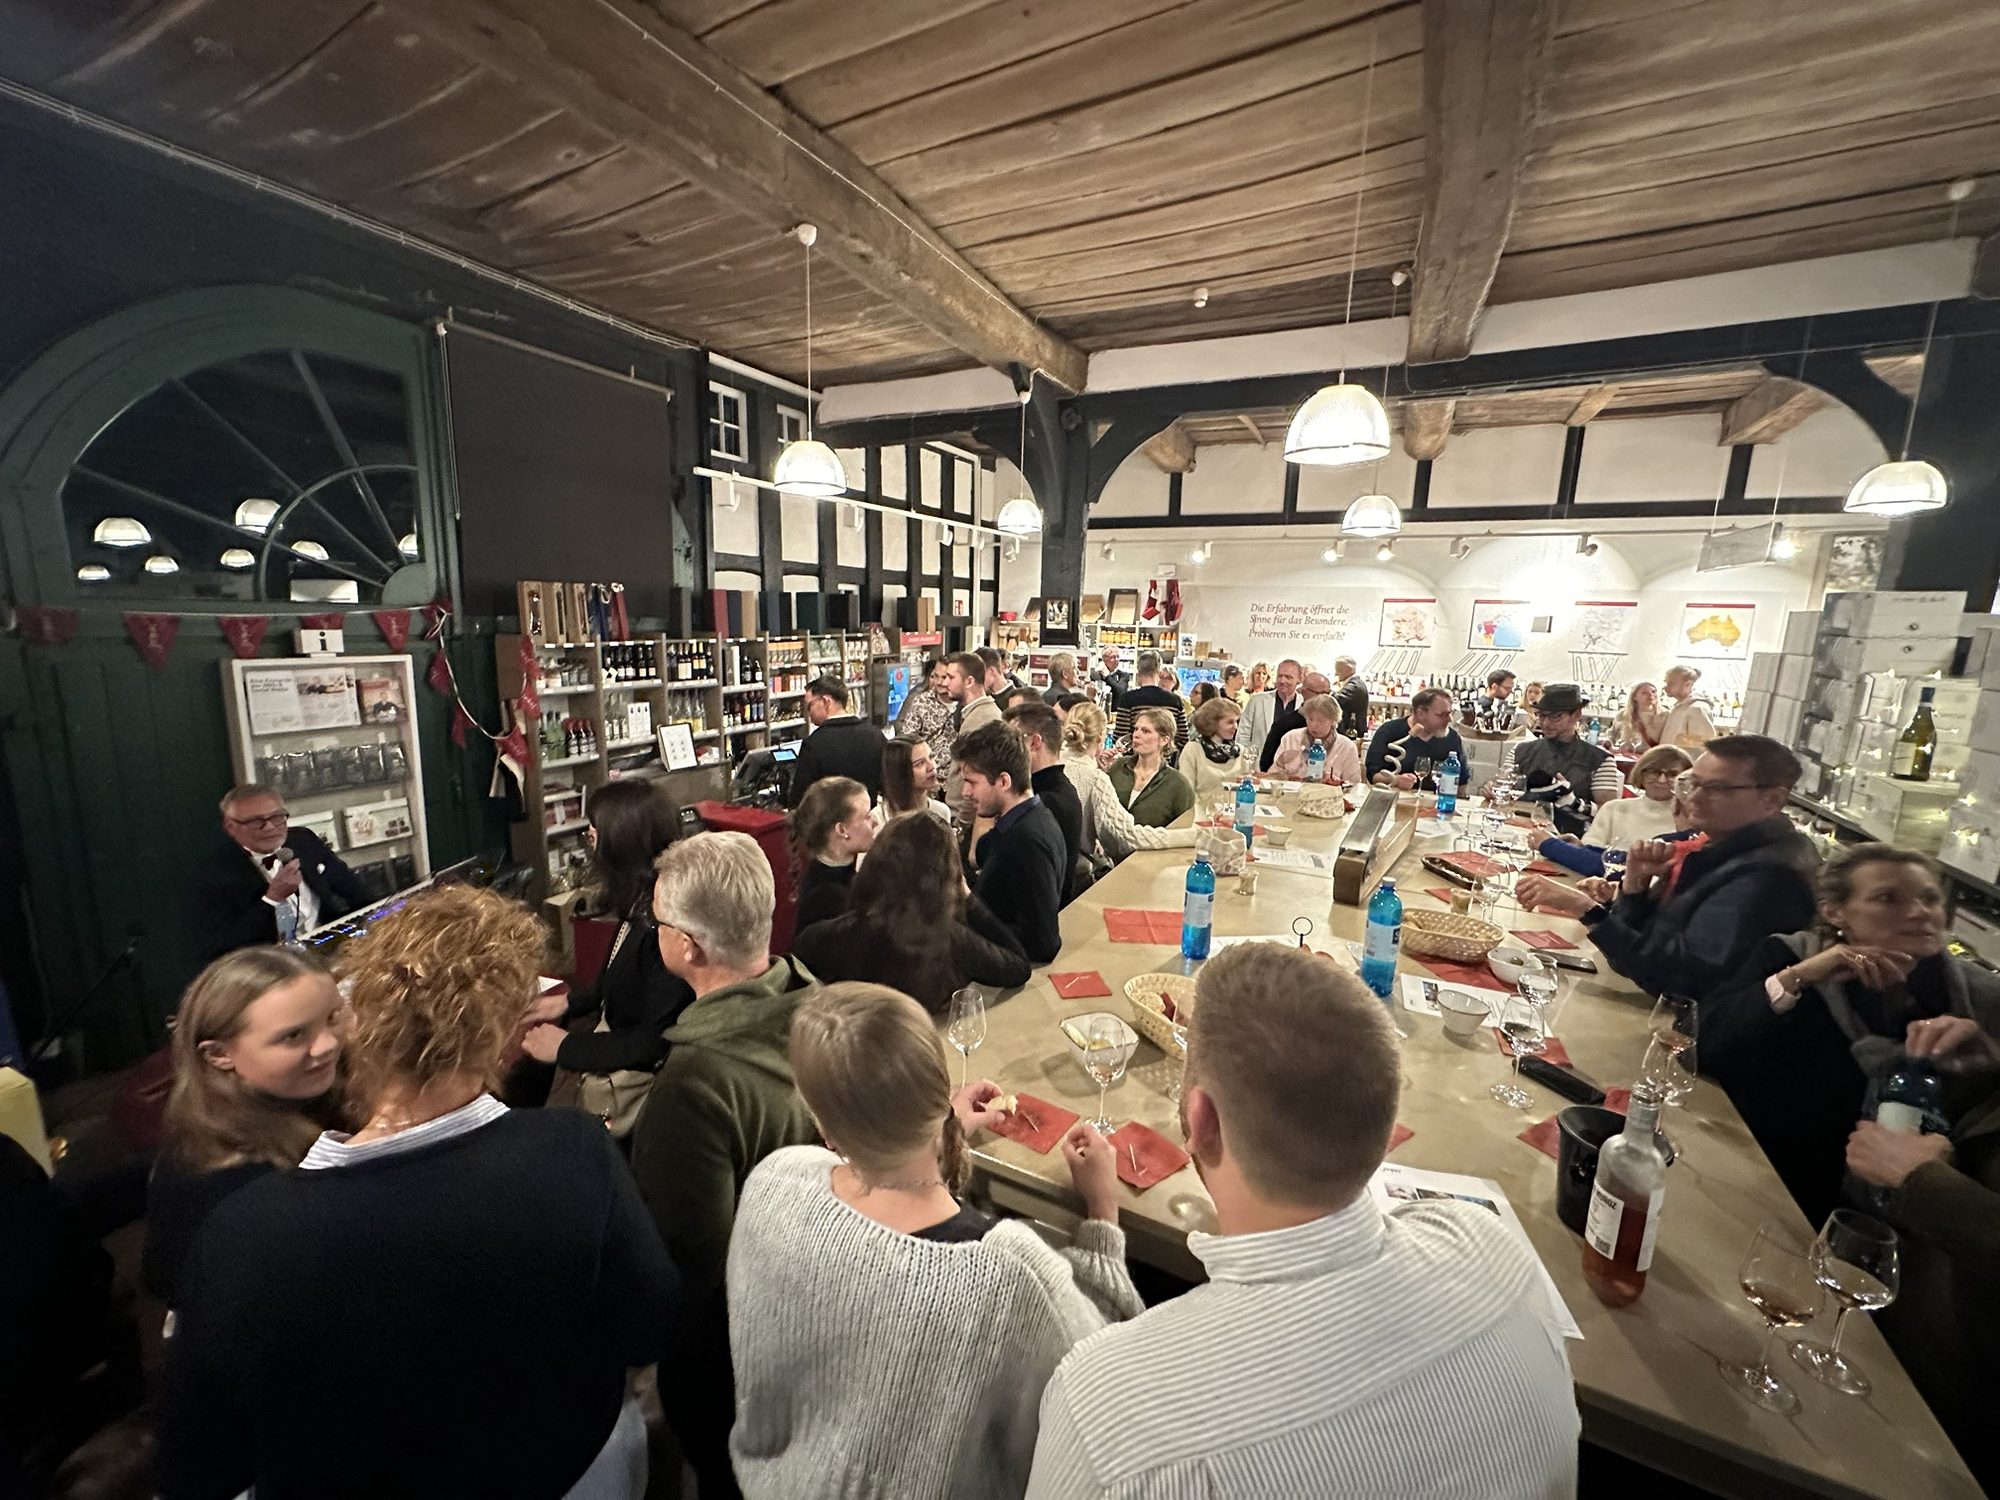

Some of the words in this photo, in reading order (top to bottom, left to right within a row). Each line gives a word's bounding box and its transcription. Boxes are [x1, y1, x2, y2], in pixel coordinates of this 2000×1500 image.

[1250, 603, 1264, 613] Die
[1266, 603, 1308, 616] Erfahrung
[1309, 604, 1334, 616] öffnet
[1336, 604, 1349, 614] die
[1249, 614, 1271, 624] Sinne
[1272, 614, 1287, 626] für
[1288, 615, 1302, 625] das
[1248, 629, 1286, 639] Probieren
[1288, 630, 1300, 639] Sie
[1302, 632, 1310, 640] es
